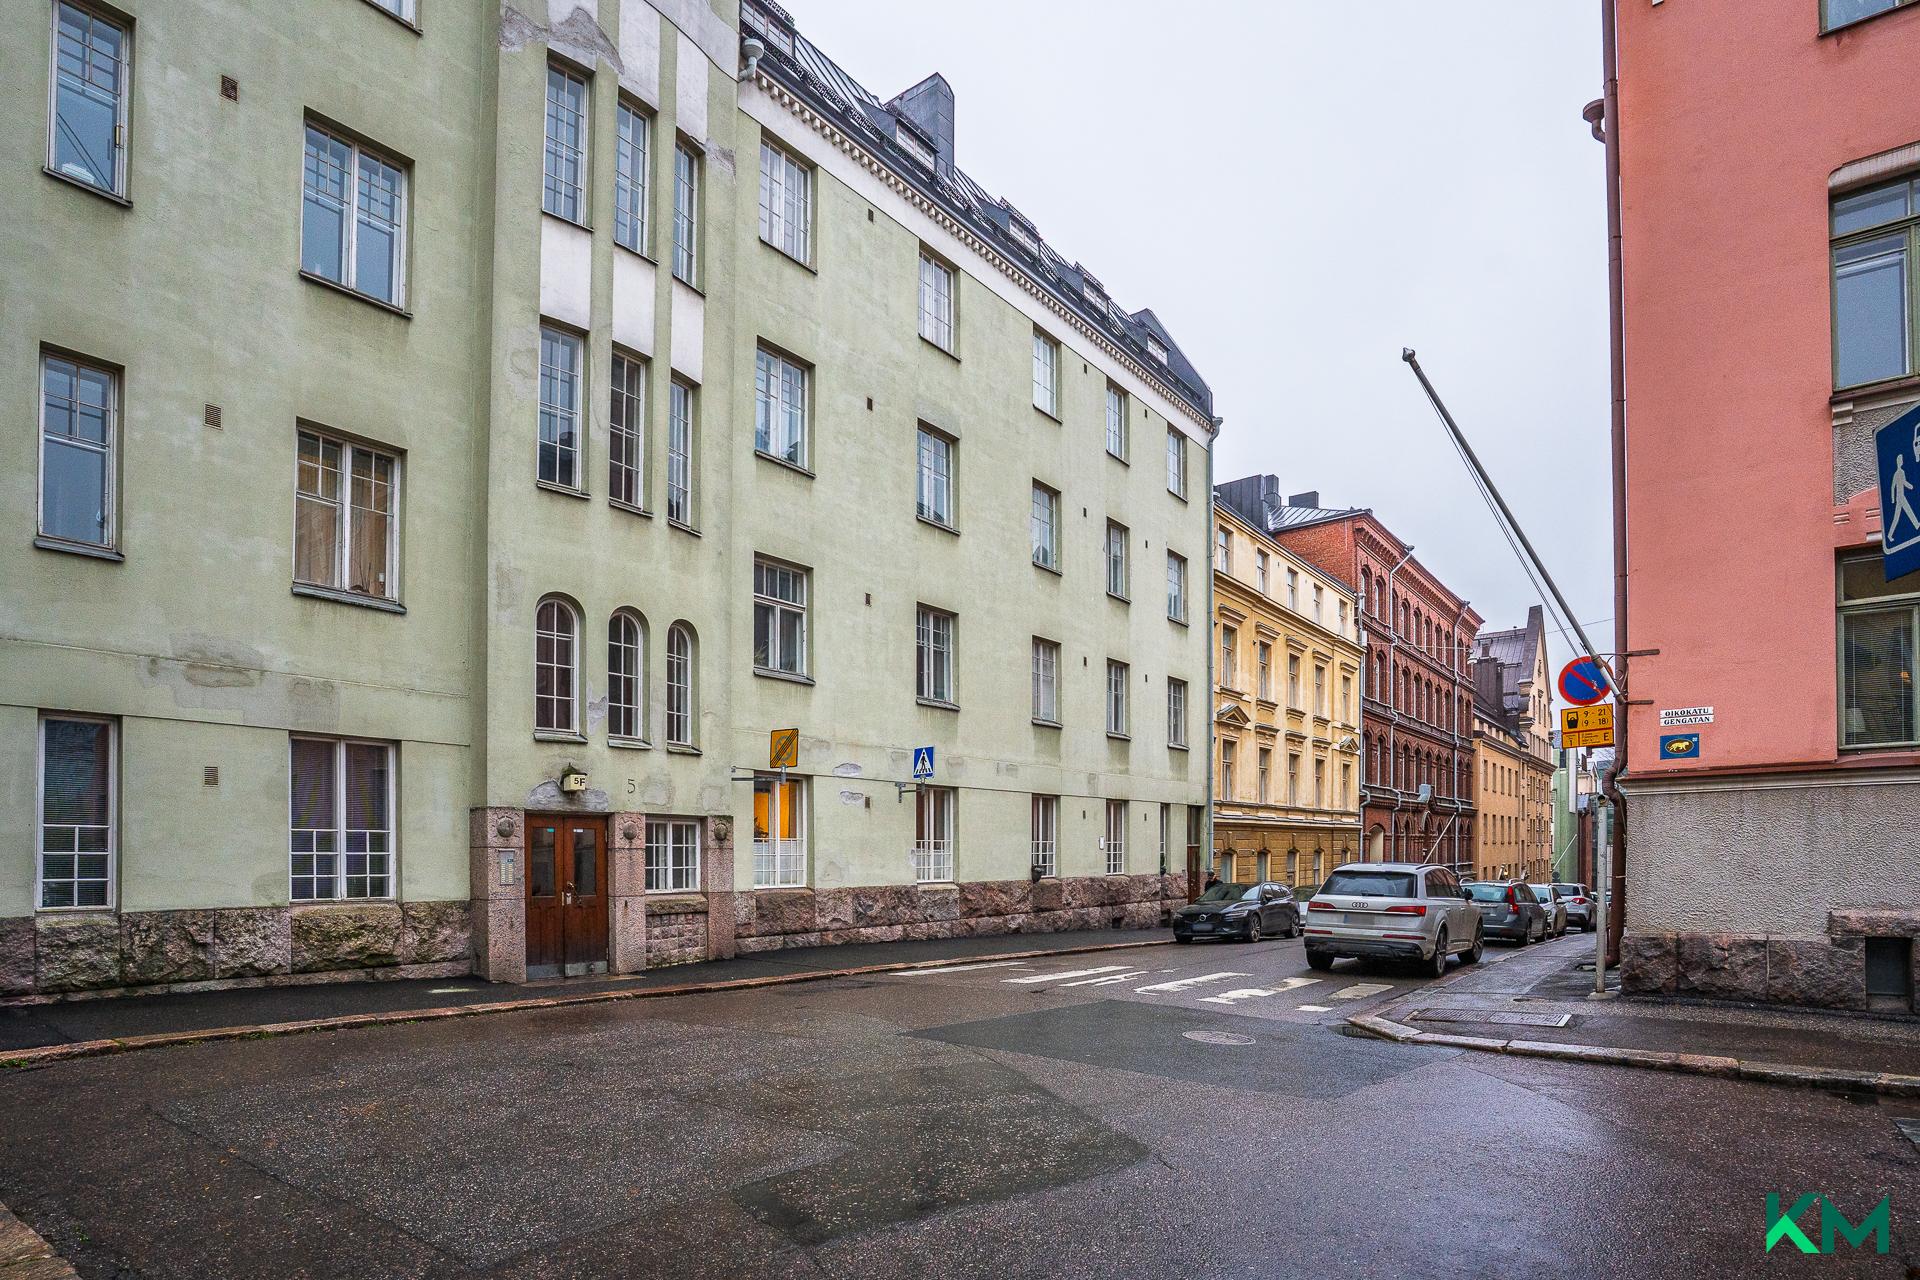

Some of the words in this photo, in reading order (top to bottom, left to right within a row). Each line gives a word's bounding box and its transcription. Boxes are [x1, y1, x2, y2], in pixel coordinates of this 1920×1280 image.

[1598, 708, 1606, 716] 21
[1665, 708, 1709, 716] OIKOKATU
[1664, 716, 1710, 725] GENGATAN
[1603, 732, 1609, 741] E
[574, 777, 585, 786] 5F
[627, 778, 636, 794] 5
